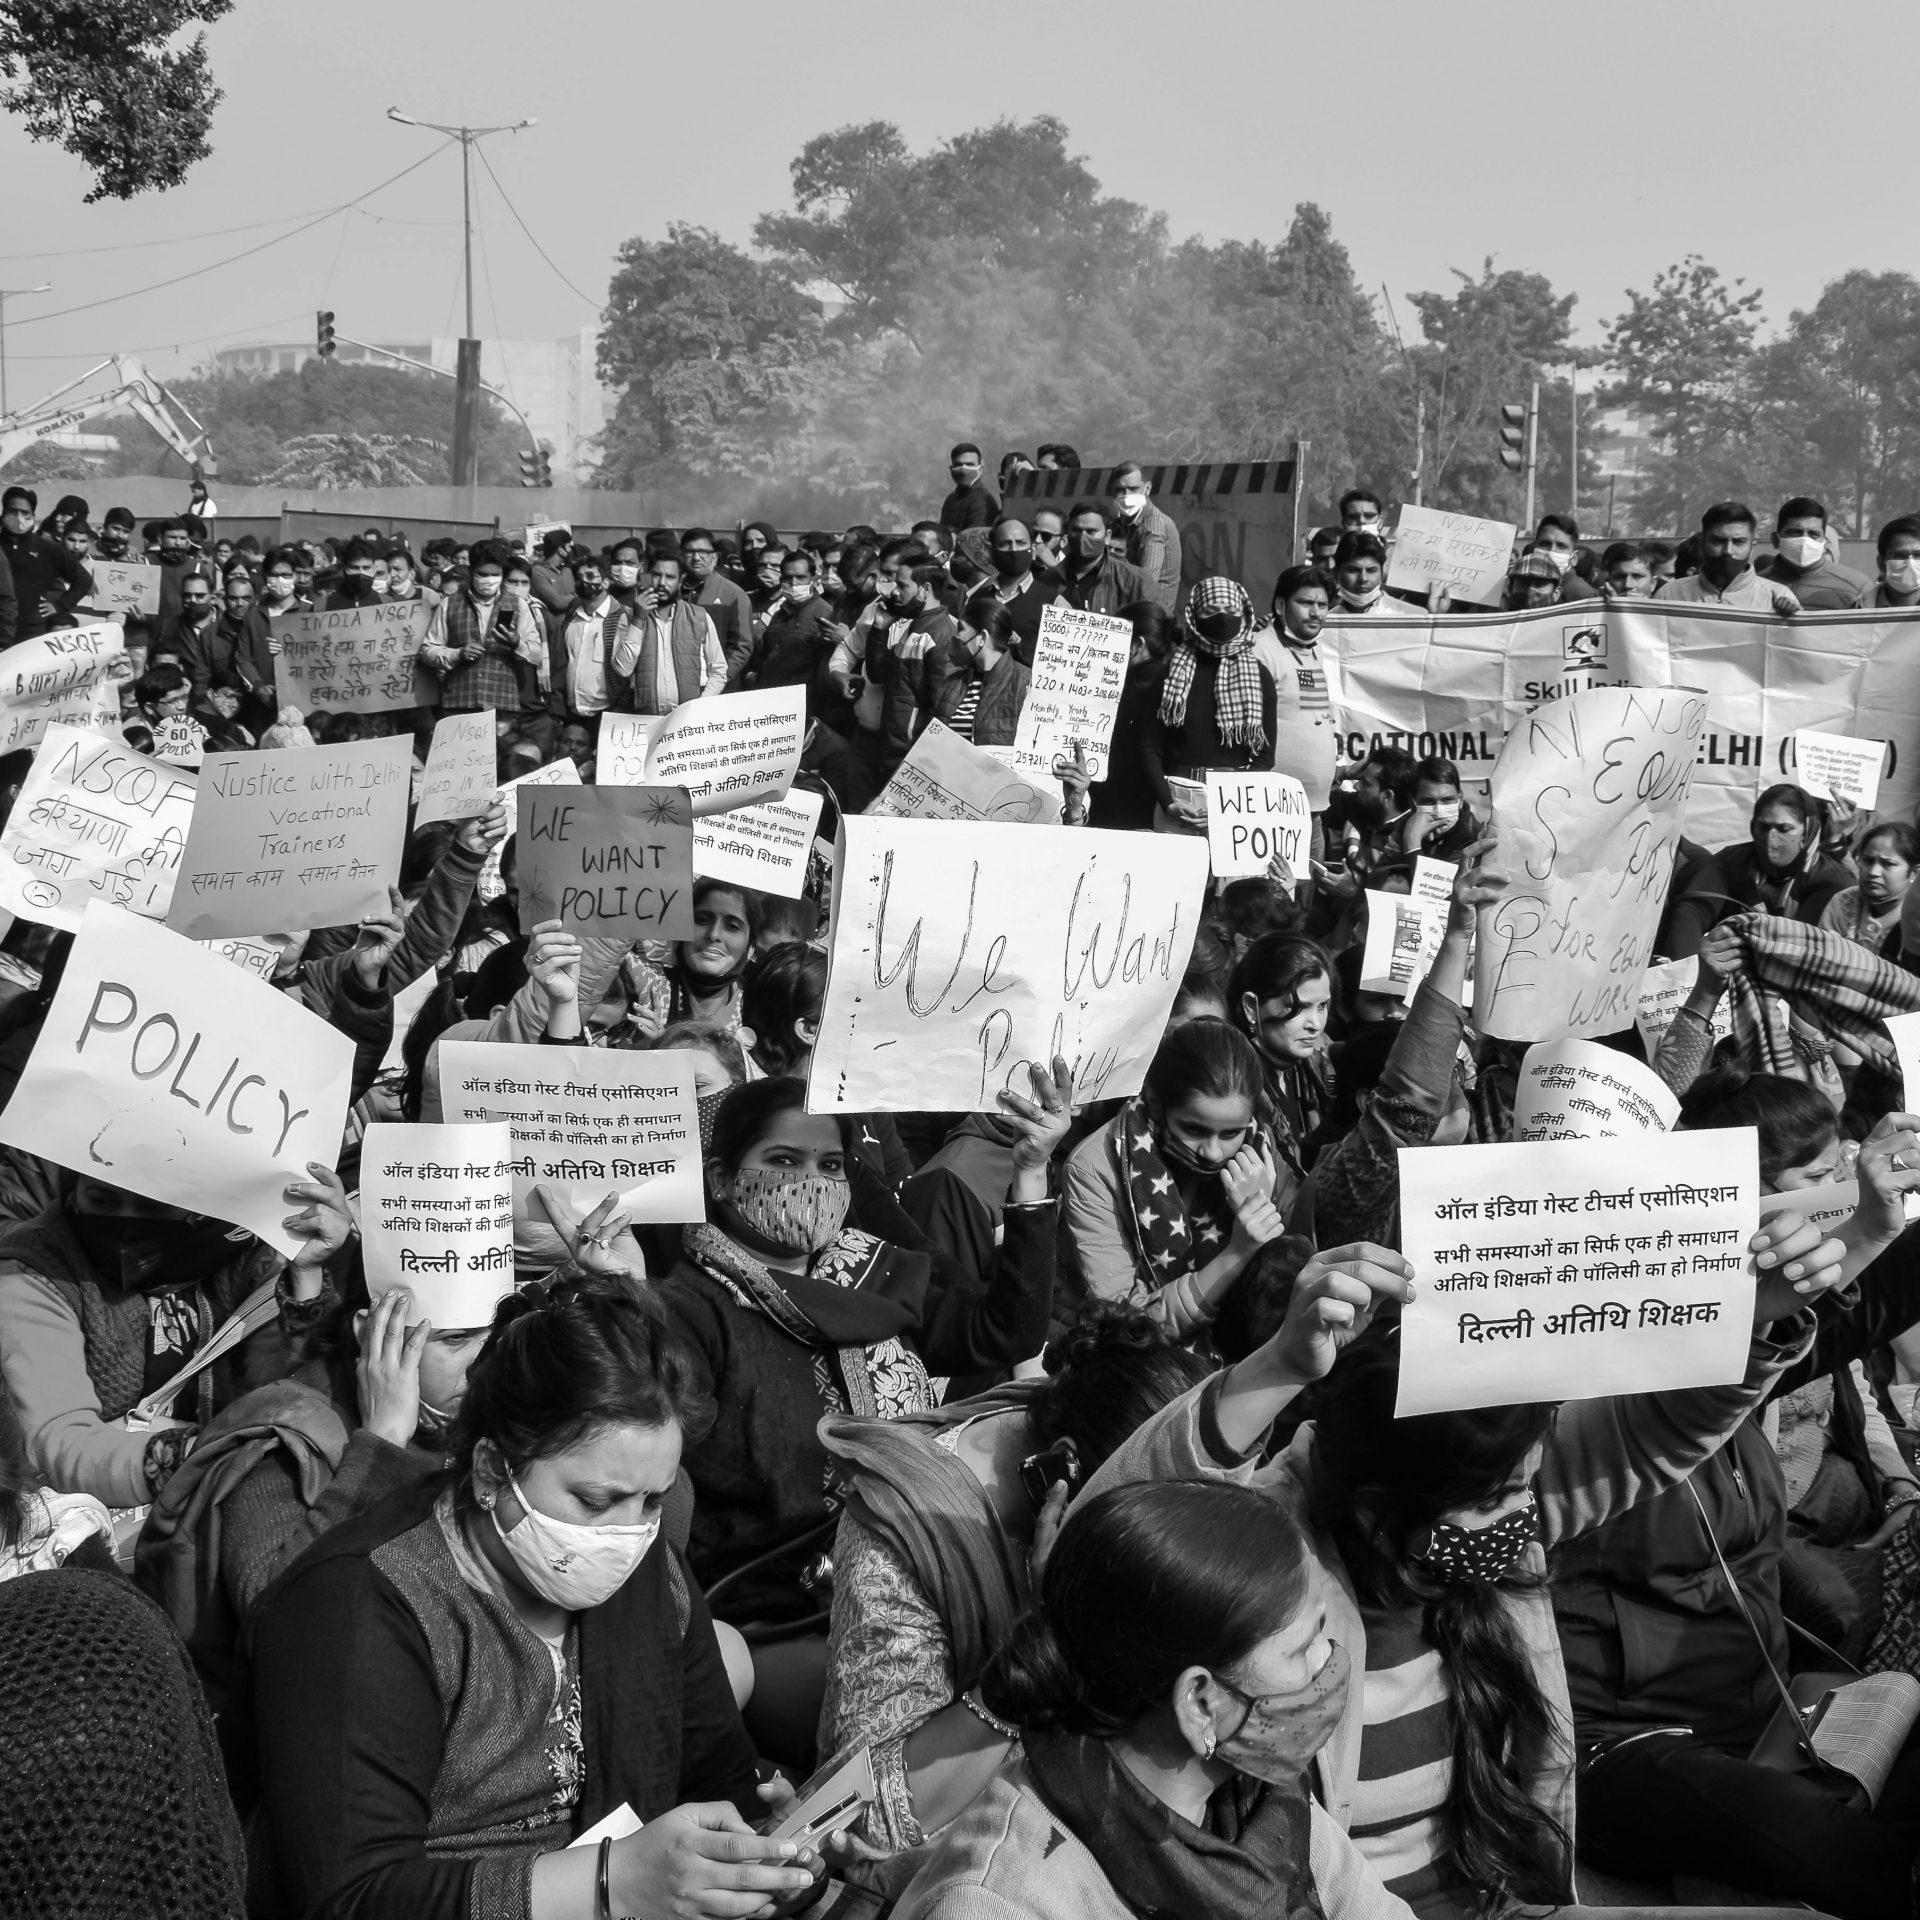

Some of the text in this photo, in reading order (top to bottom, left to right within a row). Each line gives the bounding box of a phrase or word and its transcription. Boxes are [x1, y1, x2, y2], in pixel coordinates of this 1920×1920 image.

[36, 411, 86, 437] KOMATSU
[300, 602, 423, 631] INDIA NSQF
[44, 632, 104, 655] NSQF
[1035, 675, 1057, 691] 220
[1525, 677, 1579, 700] Skill
[1031, 702, 1088, 718] Monthly Yearly
[1034, 714, 1090, 723] income income
[153, 725, 168, 737] WE
[171, 728, 187, 740] 60
[172, 714, 203, 735] WANT
[611, 722, 648, 748] WE
[677, 726, 705, 740] इंडिया
[708, 722, 726, 733] गेस्ट
[728, 717, 752, 731] टीचर्स
[754, 713, 798, 729] एसोसिएशन
[159, 739, 197, 756] POLICY
[656, 734, 796, 764] सभी समस्याओं का सिर्फ एक ही समाधान
[1697, 734, 1763, 766] ELHI
[659, 746, 796, 777] अतिथि शिक्षकों की पॉलिसी का हो निर्माण
[51, 741, 197, 818] NSQF
[212, 762, 298, 798] Justice
[311, 763, 353, 791] with
[358, 762, 402, 789] Delhi
[715, 769, 786, 793] अतिथि शिक्षक
[888, 779, 925, 810] पॉलिसी
[1219, 785, 1306, 816] WE WANT
[28, 794, 133, 857] हरियाणा
[531, 801, 576, 841] WE
[729, 813, 806, 838] का सिर्फ एक ही समाधान
[767, 804, 810, 822] एसोसिएशन
[259, 833, 346, 859] Trainers
[701, 817, 725, 829] शिक्षकों
[726, 823, 736, 832] की
[737, 825, 762, 838] पॉलिसी
[763, 833, 772, 841] का
[773, 834, 781, 843] हो
[782, 836, 804, 849] निर्माण
[142, 826, 187, 869] की
[582, 845, 667, 873] WANT
[717, 840, 793, 867] अतिथि शिक्षक
[13, 845, 81, 877] जाग
[191, 872, 243, 895] समान
[246, 869, 286, 887] काम
[298, 865, 347, 885] समान
[560, 886, 679, 925] POLICY
[873, 848, 1180, 1018] We Want
[1568, 983, 1631, 1027] WORK
[76, 981, 309, 1158] POLICY
[1530, 1065, 1548, 1076] ऑल
[1549, 1064, 1576, 1076] इंडिया
[1577, 1066, 1600, 1082] गेस्ट
[1601, 1074, 1632, 1096] टीचर्स
[1540, 1075, 1576, 1090] पॉलिसी
[462, 1077, 679, 1101] ऑल इंडिया गेस्ट टीचर्स एसोसिएशन
[462, 1107, 682, 1129] सभी का सिर्फ एक ही समाधान
[1530, 1111, 1565, 1126] पॉलिसी
[1568, 1097, 1611, 1122] पॉलिसी
[1617, 1097, 1650, 1130] पॉलिसी
[549, 1128, 687, 1146] की पॉलिसी का हो निर्माण
[382, 1161, 491, 1180] ऑल इंडिया गेस्ट
[543, 1157, 676, 1180] अतिथि शिक्षक
[381, 1196, 407, 1210] सभी
[411, 1196, 472, 1211] समस्याओं
[475, 1198, 491, 1211] का
[1434, 1184, 1739, 1221] ऑल इंडिया गेस्ट टीचर्स एसोसिएशन
[1808, 1208, 1844, 1222] इंडिया
[381, 1216, 491, 1233] अतिथि शिक्षकों की
[1434, 1229, 1739, 1265] सभी समस्याओं का सिर्फ एक ही समाधान
[400, 1248, 460, 1273] दिल्ली
[1434, 1255, 1742, 1292] अतिथि शिक्षकों की पॉलिसी का हो निर्माण
[1457, 1299, 1721, 1344] दिल्ली अतिथि शिक्षक
